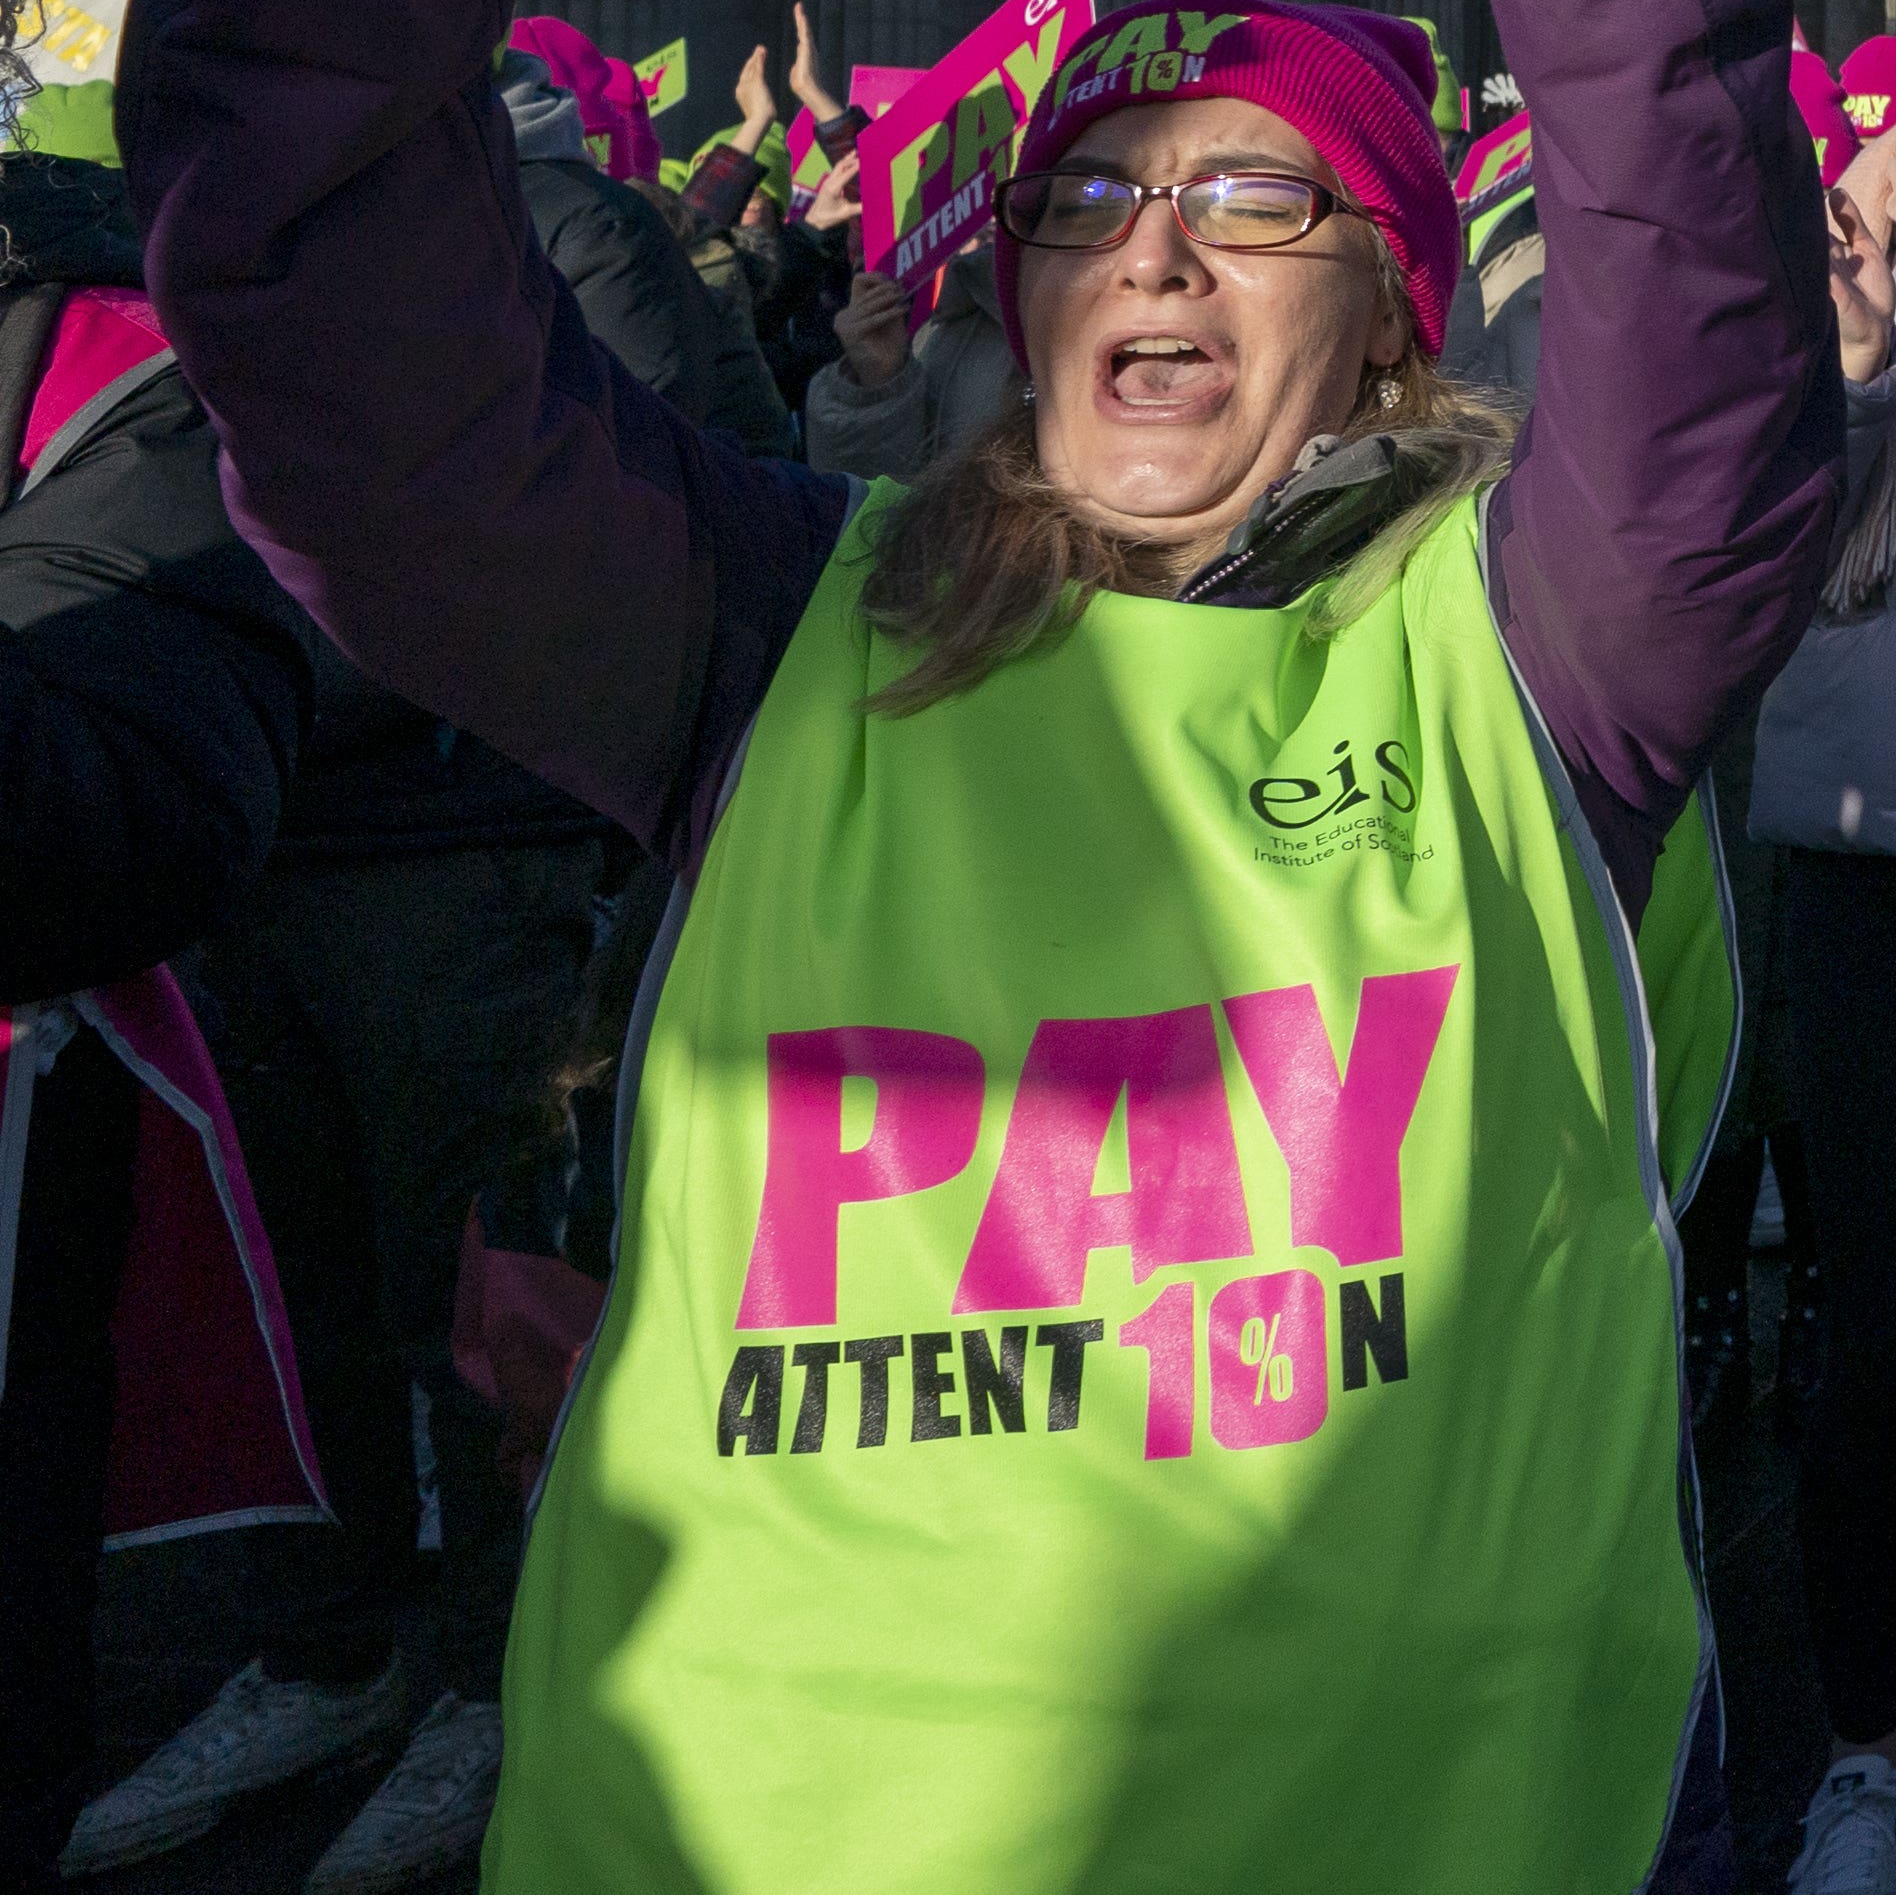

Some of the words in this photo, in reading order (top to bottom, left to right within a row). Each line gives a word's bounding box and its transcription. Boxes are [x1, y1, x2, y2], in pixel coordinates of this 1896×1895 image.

[1054, 9, 1250, 110] PAY
[889, 7, 1066, 242] PAY
[1248, 739, 1417, 830] eis
[1253, 847, 1336, 868] Institute
[1340, 834, 1362, 851] of
[1269, 835, 1309, 852] The
[733, 962, 1461, 1331] PAY
